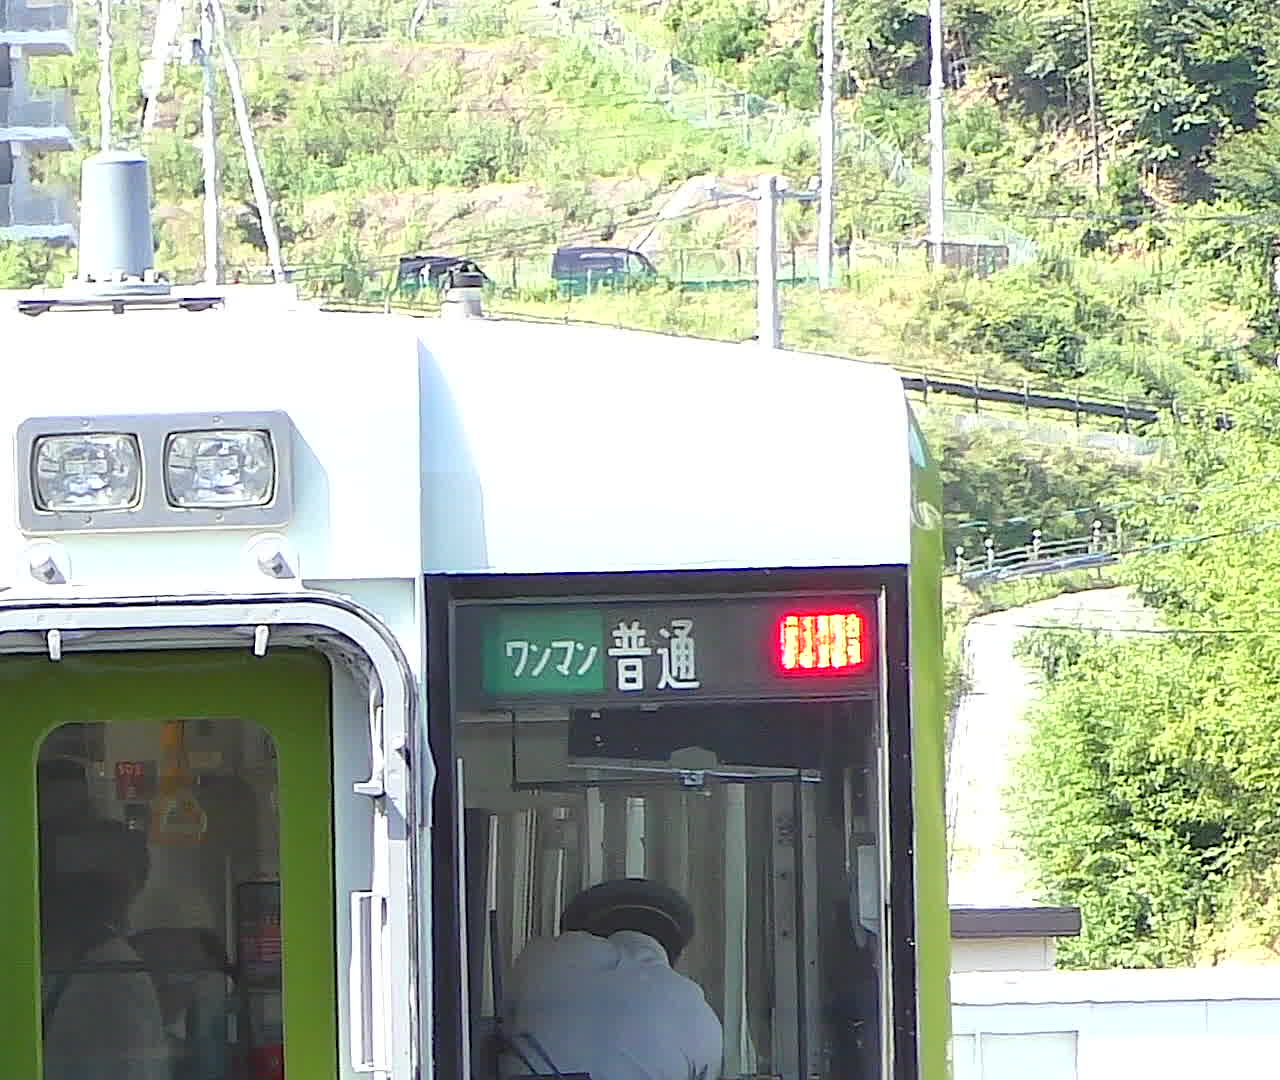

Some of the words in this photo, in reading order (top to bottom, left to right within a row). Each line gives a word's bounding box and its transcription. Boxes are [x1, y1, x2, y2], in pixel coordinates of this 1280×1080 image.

[506, 641, 598, 677] ワンマン
[607, 619, 701, 691] 普通
